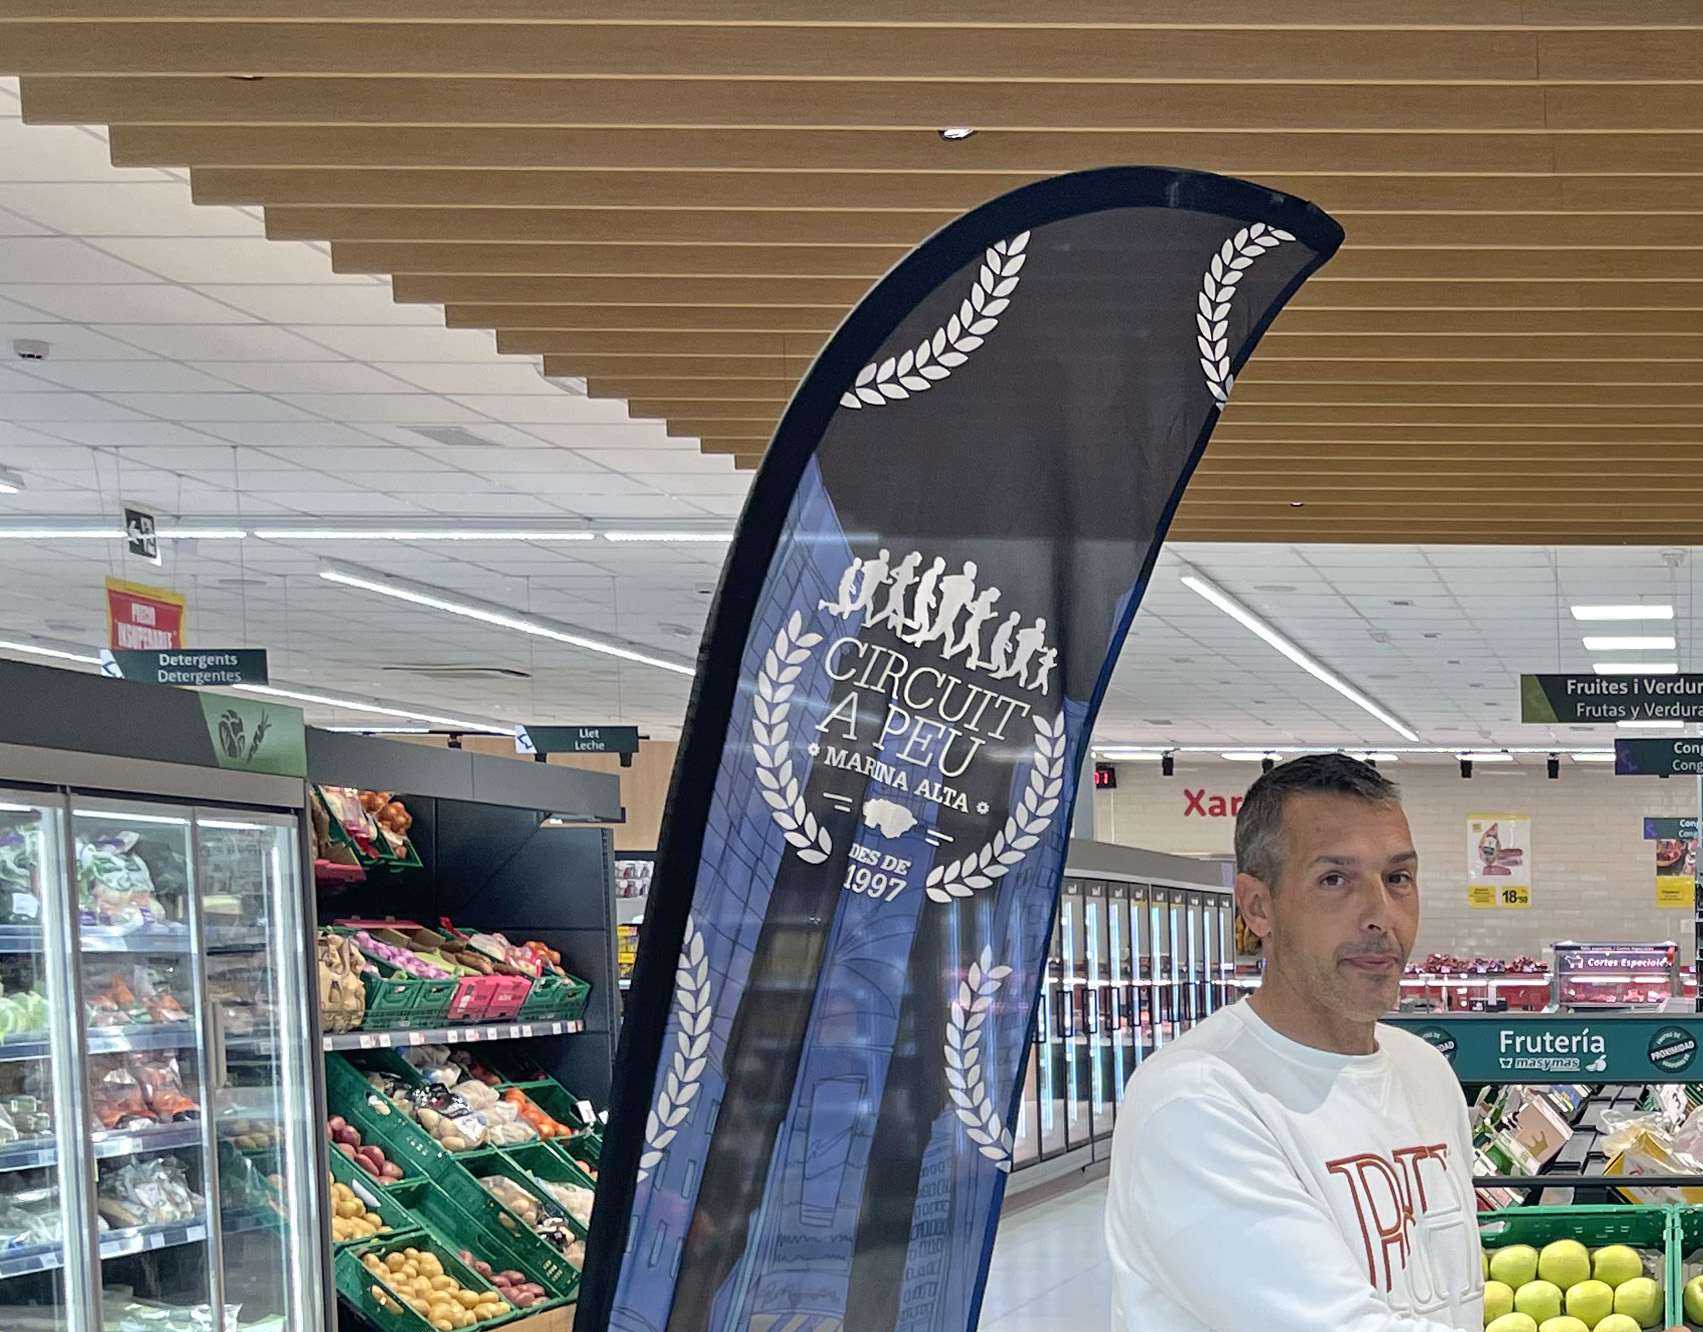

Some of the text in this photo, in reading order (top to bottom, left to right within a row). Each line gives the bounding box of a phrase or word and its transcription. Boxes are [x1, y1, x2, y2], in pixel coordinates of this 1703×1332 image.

[159, 653, 238, 669] Detergents
[158, 669, 242, 685] Detergentes
[825, 637, 1031, 740] CIRCUIT
[1567, 679, 1628, 695] Fruites
[1634, 679, 1639, 694] i
[1576, 702, 1626, 717] Frutas
[1630, 704, 1640, 720] y
[579, 728, 600, 738] Llet
[815, 691, 986, 778] A PEU
[574, 741, 605, 751] Leche
[824, 746, 969, 813] MARINA ALTA
[848, 843, 911, 876] DES DE
[844, 864, 908, 902] 1997
[1587, 958, 1618, 968] Cortes
[1500, 1028, 1605, 1053] Frutería
[1650, 1040, 1696, 1062] PROXIMIDAD
[1515, 1057, 1580, 1071] masymas
